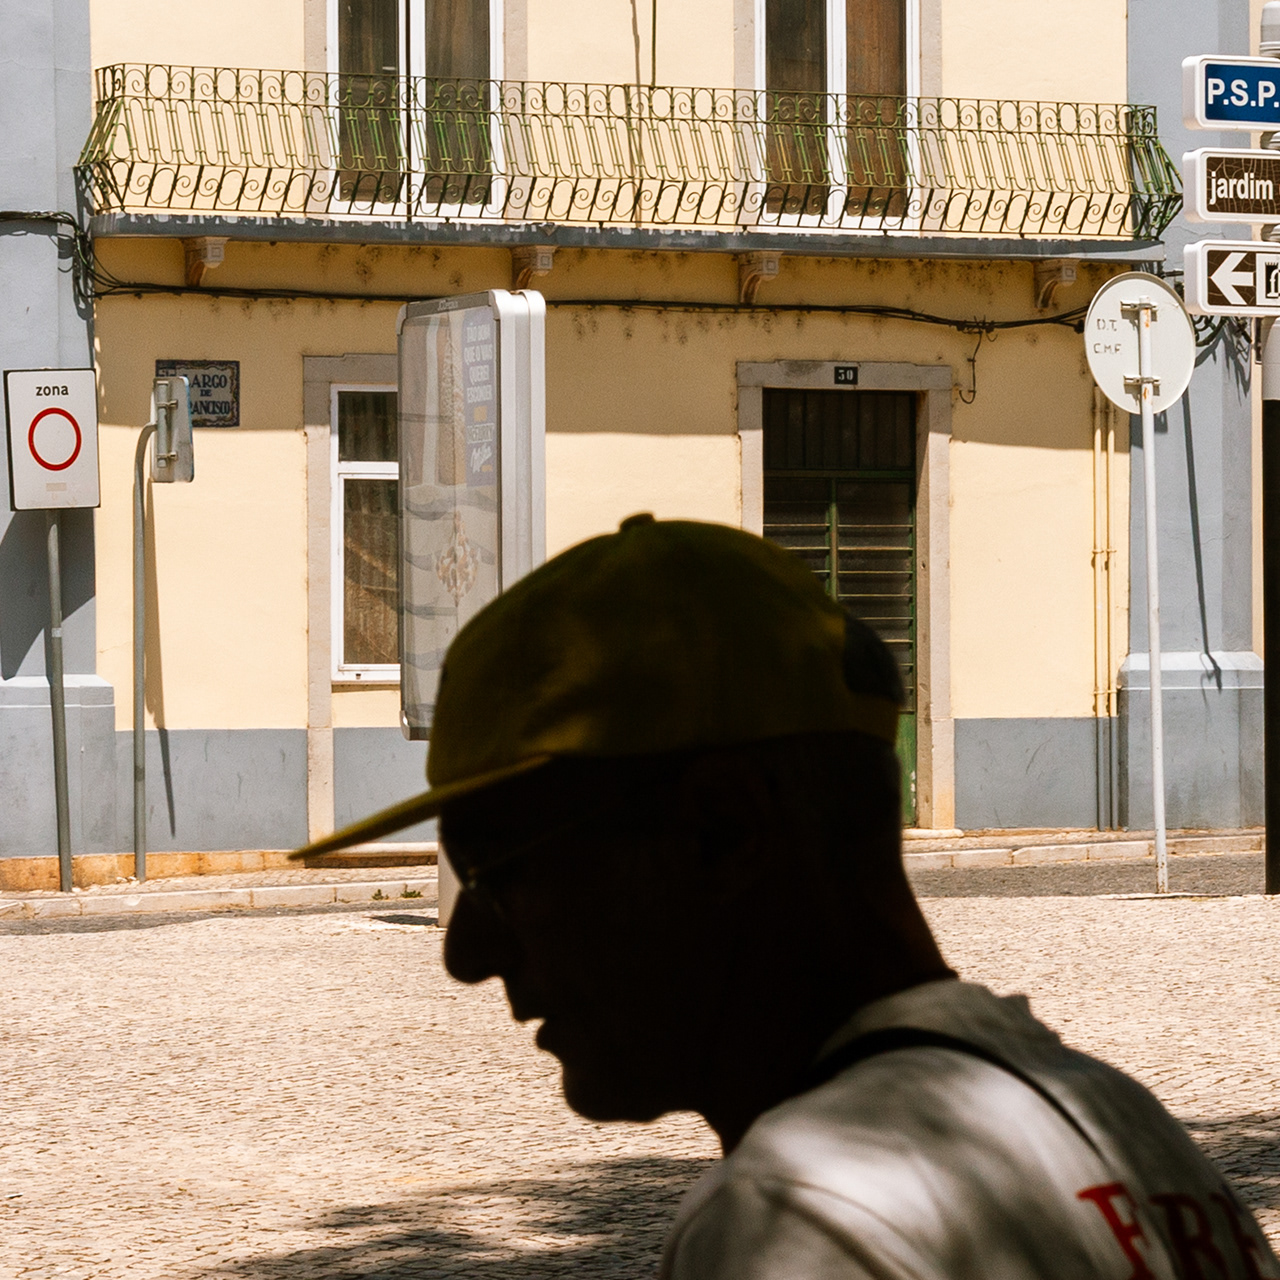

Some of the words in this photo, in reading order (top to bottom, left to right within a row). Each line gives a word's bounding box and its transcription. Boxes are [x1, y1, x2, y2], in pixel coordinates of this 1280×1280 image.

[1207, 78, 1280, 108] P.S.P.
[1209, 172, 1274, 204] jardim
[35, 383, 69, 397] zona
[200, 389, 212, 397] DE
